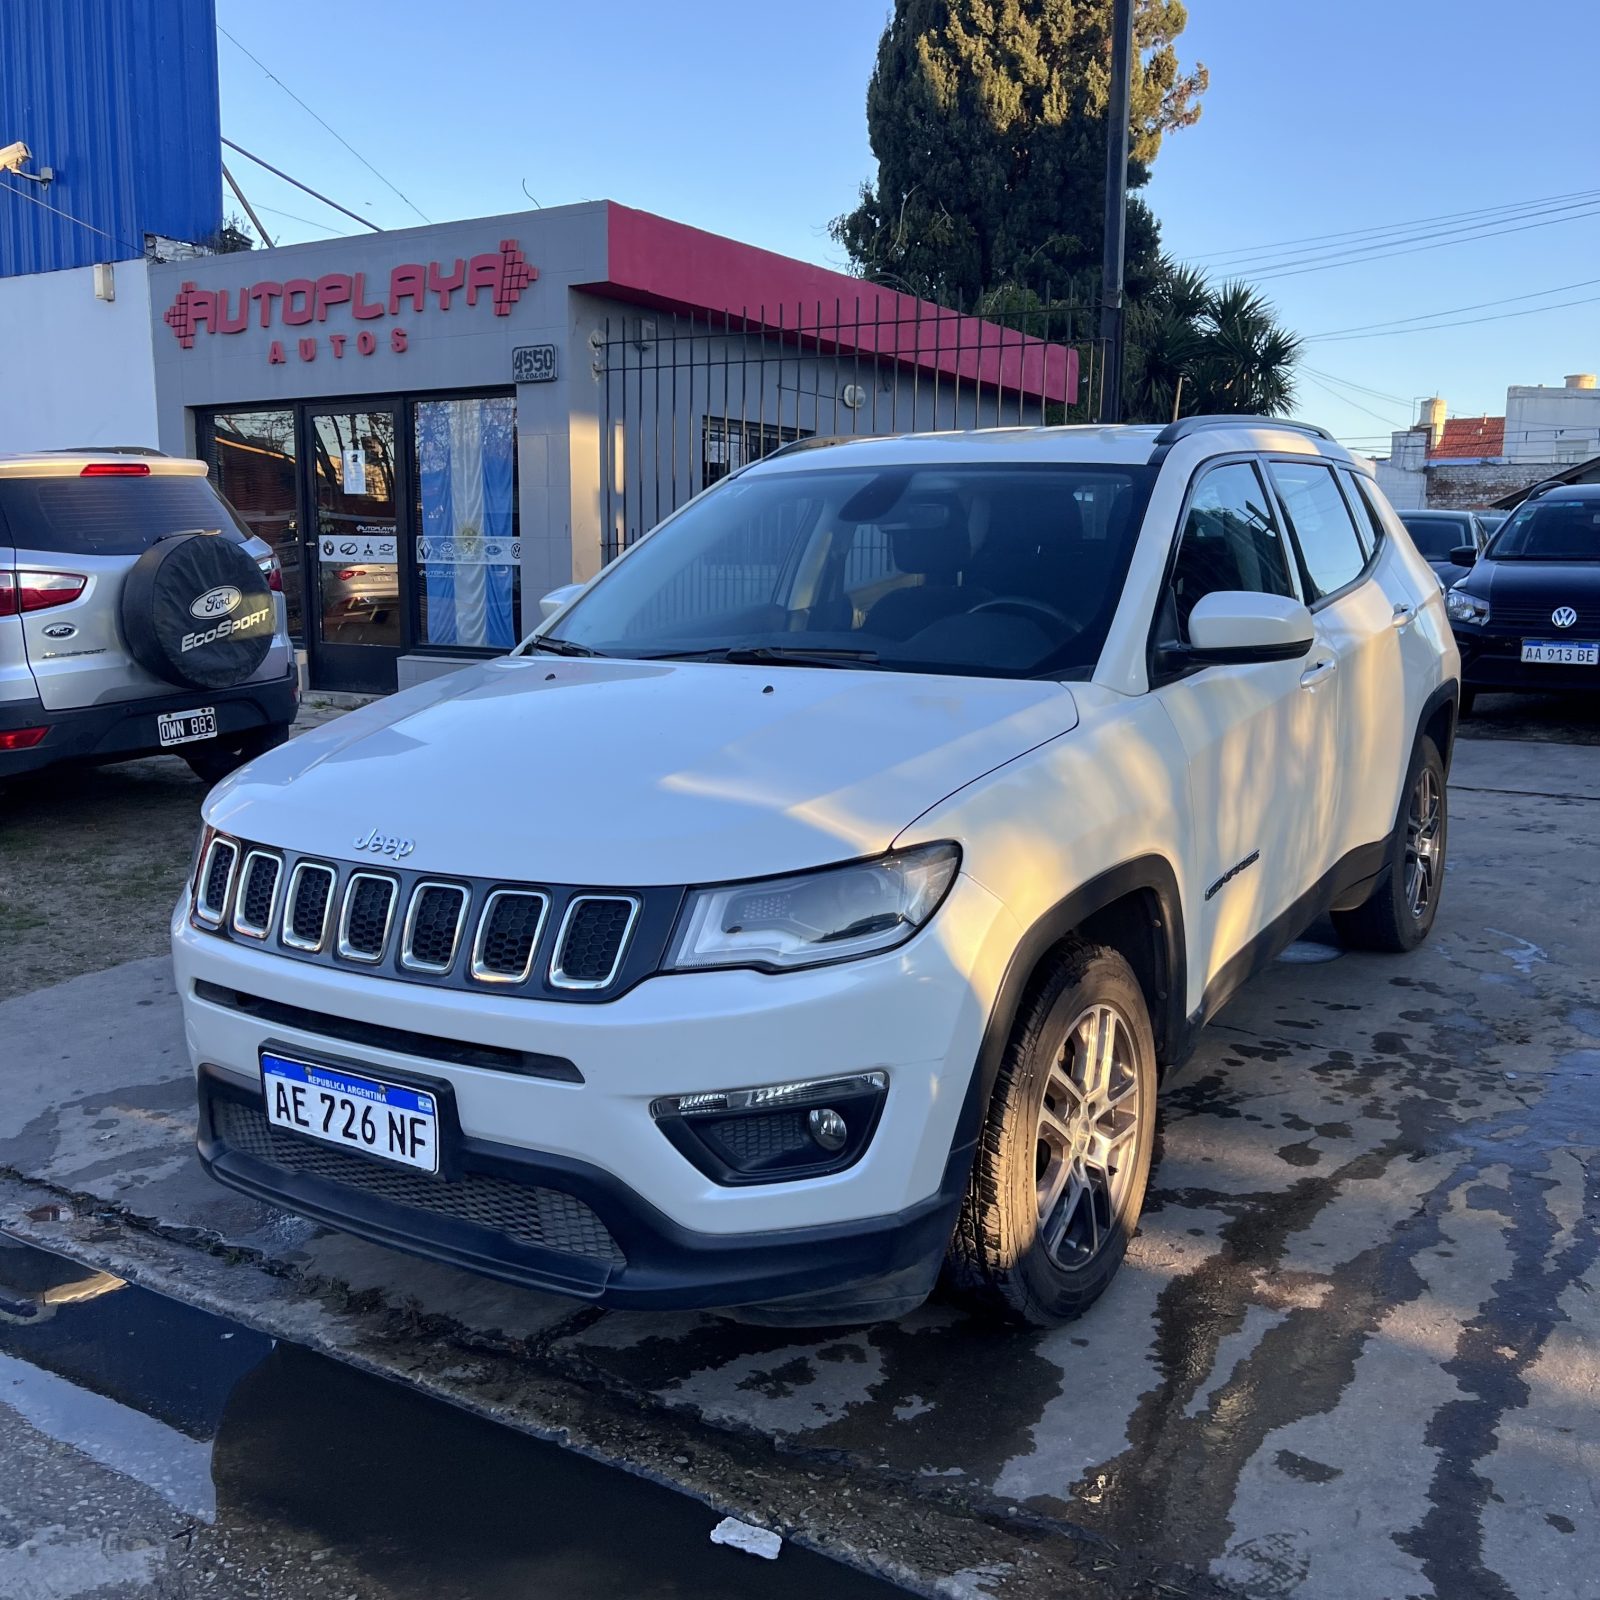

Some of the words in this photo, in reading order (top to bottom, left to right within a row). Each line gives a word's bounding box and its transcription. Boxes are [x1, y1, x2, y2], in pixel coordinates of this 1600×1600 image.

[186, 253, 502, 334] AUTOPLAYA
[268, 327, 409, 365] AUTOS
[514, 349, 553, 373] 4550
[205, 592, 231, 613] Ford
[1525, 647, 1542, 660] AA
[1547, 648, 1573, 662] 913
[1577, 649, 1595, 663] BE
[161, 720, 185, 740] OWN
[190, 715, 215, 735] 883
[352, 827, 416, 861] Jeep
[307, 1074, 346, 1092] REPUBLICA
[347, 1084, 387, 1103] ARGENTINA
[276, 1081, 310, 1128] AE
[319, 1092, 376, 1145] 726
[387, 1110, 427, 1159] NF
